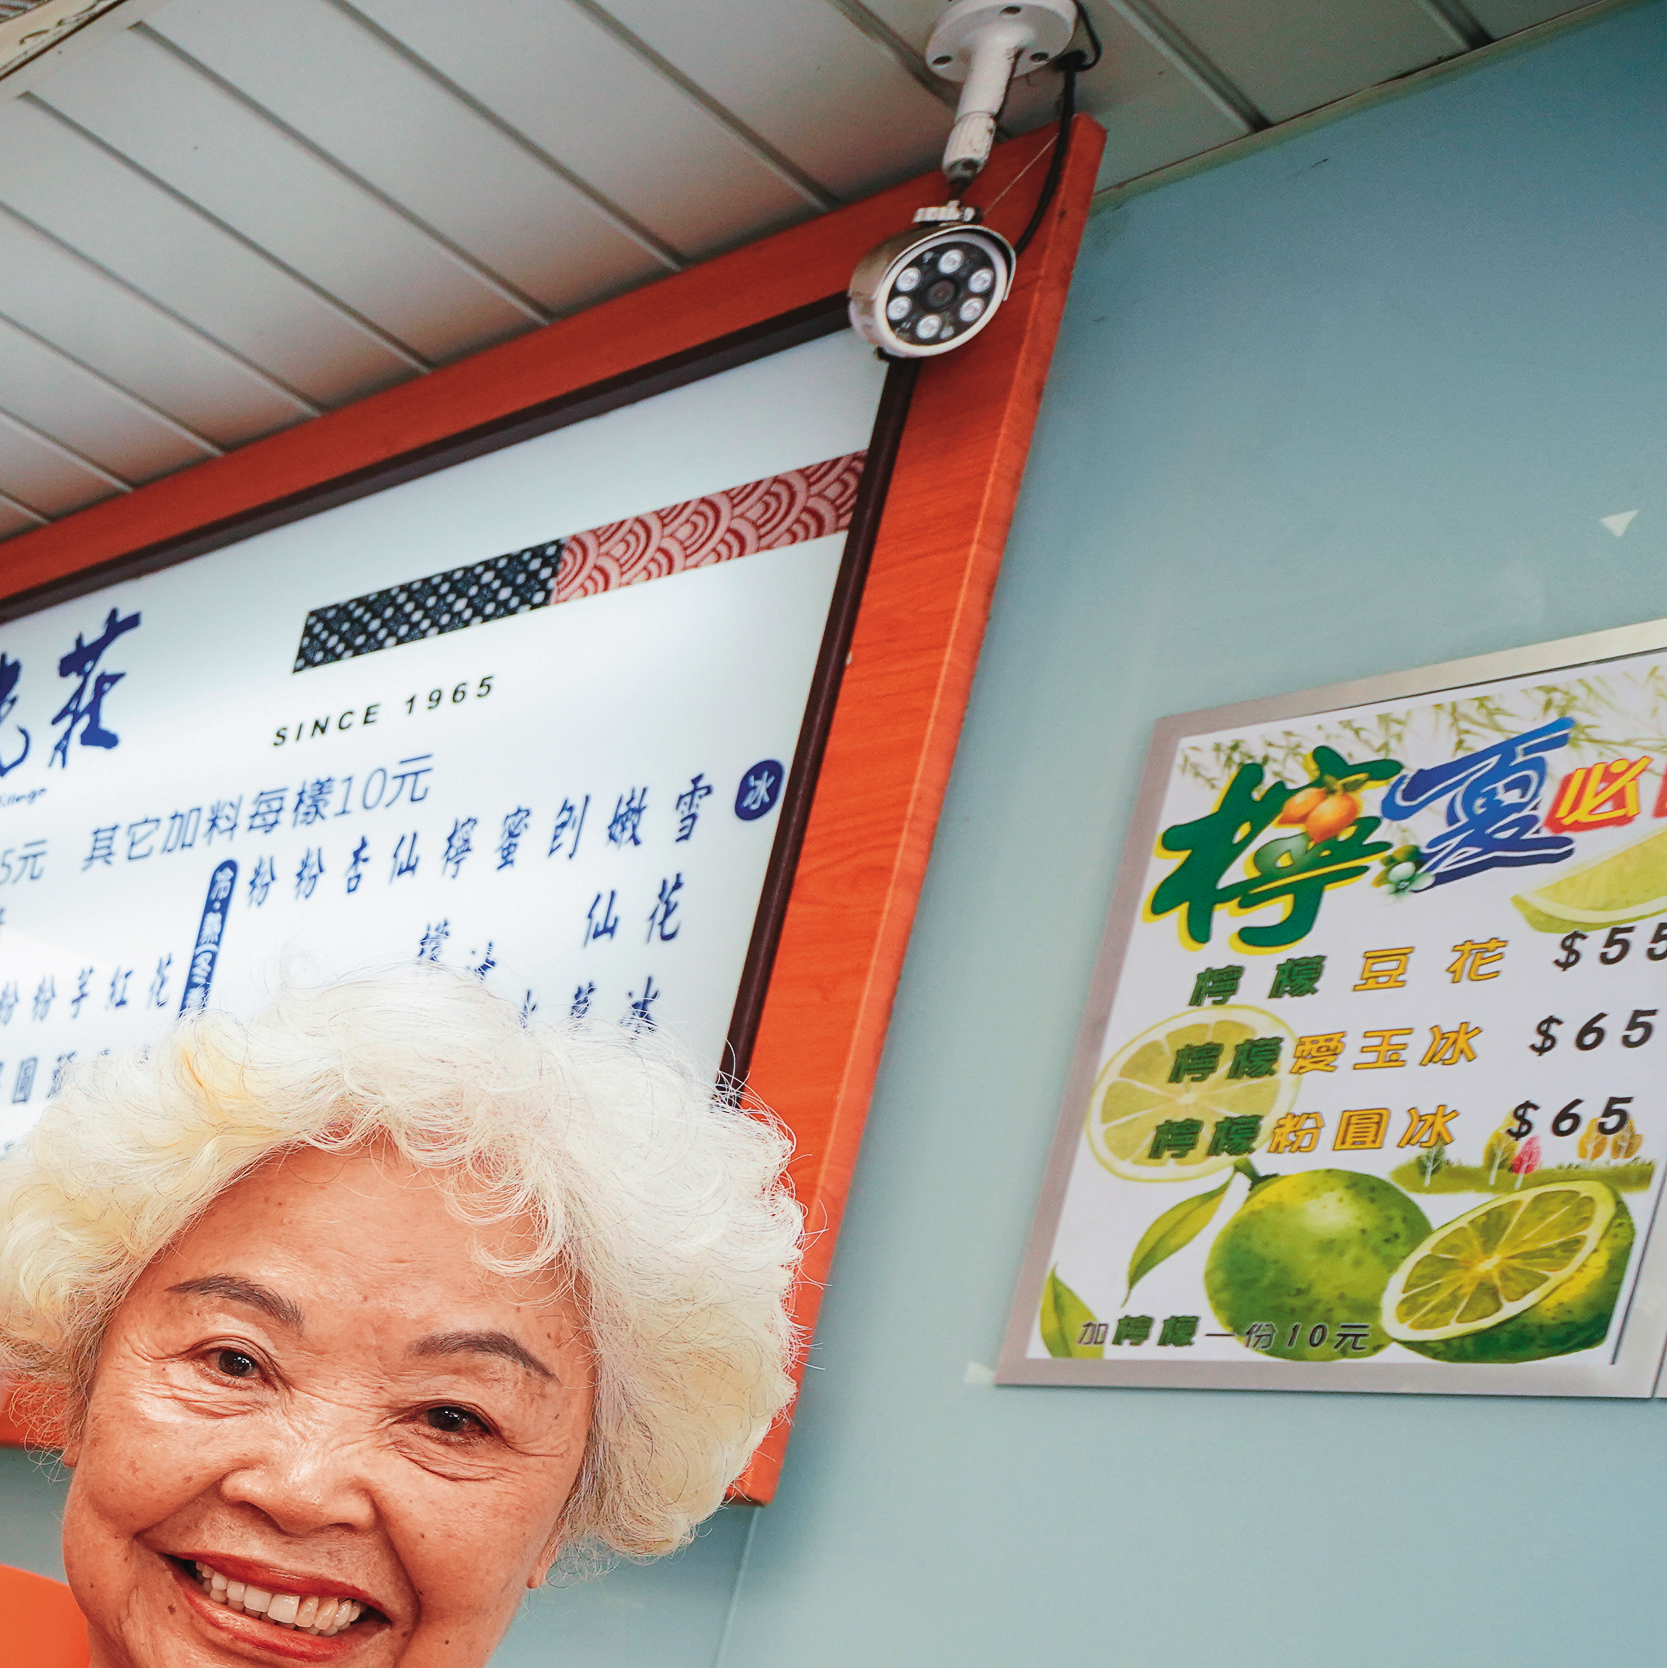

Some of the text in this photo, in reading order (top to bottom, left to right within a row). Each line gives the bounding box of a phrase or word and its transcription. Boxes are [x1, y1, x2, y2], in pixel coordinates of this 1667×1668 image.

[272, 675, 496, 747] SINCE 1965
[82, 754, 434, 872] 其它加料每樣10元
[741, 768, 777, 813] 冰
[1187, 922, 1667, 1008] 檸檬豆花 $55
[1167, 1008, 1657, 1085] 檸檬愛玉冰 $65
[1148, 1096, 1635, 1163] 檸檬粉圓冰 $65
